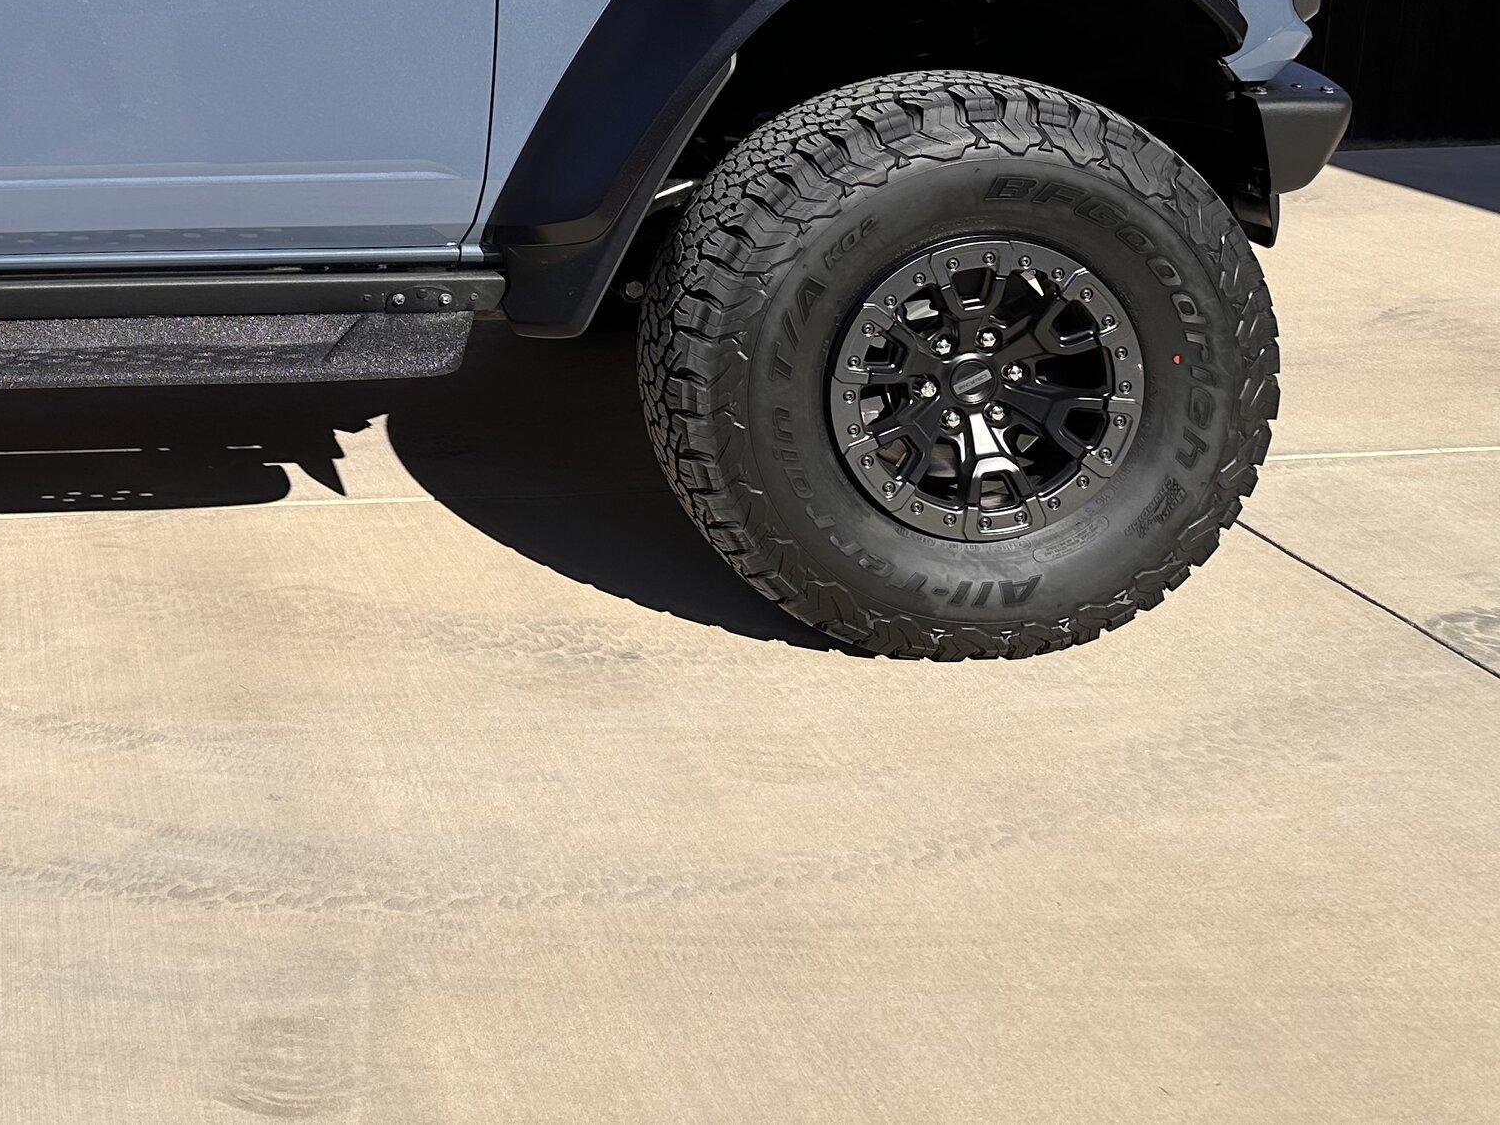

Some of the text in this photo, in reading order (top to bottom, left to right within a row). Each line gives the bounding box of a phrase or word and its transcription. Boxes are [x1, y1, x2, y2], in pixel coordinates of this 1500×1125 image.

[821, 214, 880, 270] KO2
[769, 276, 828, 383] T/A
[985, 175, 1218, 469] BFGoodrich
[770, 406, 1041, 609] All-Terrain
